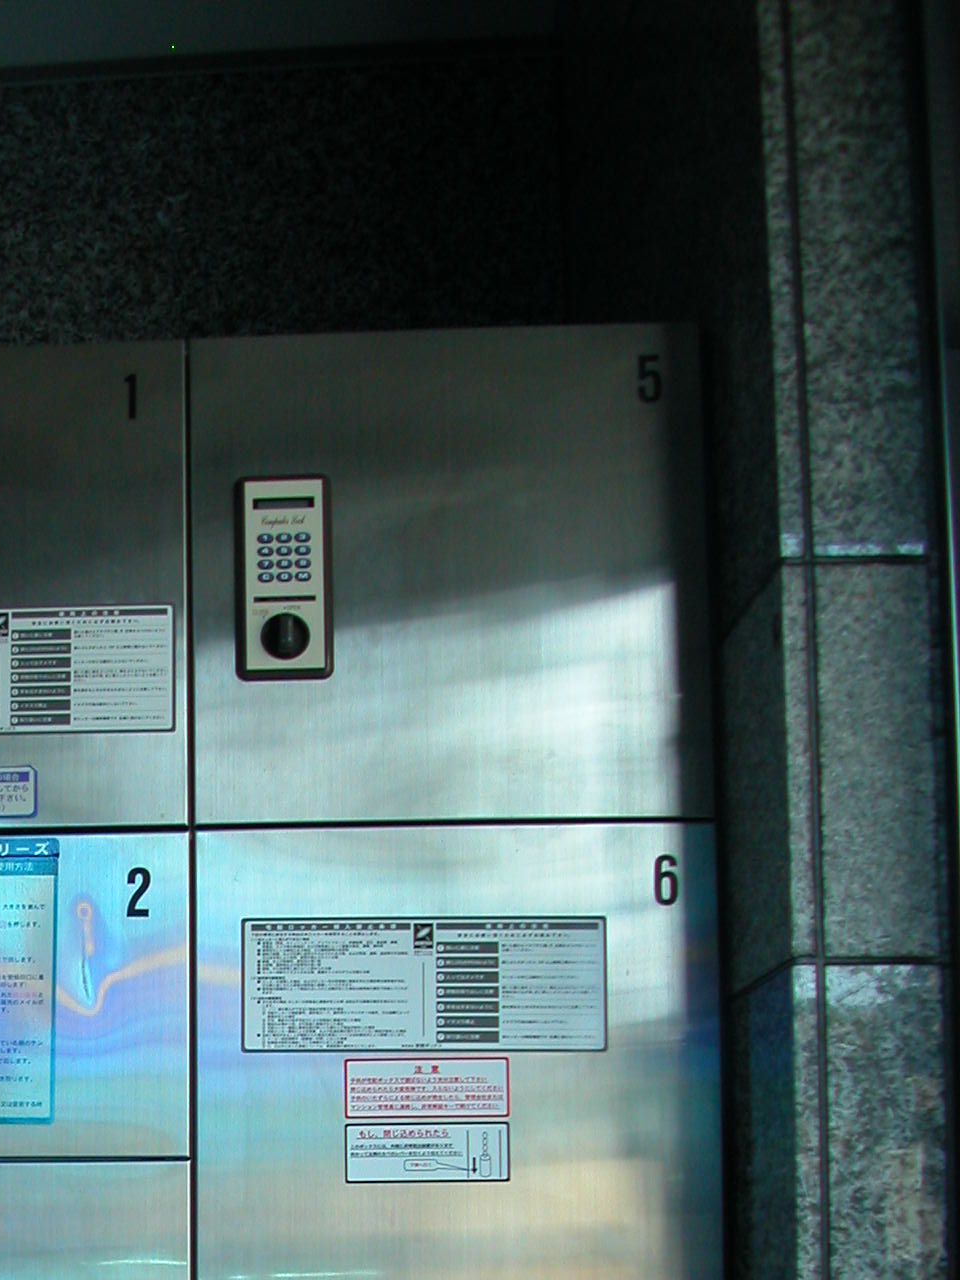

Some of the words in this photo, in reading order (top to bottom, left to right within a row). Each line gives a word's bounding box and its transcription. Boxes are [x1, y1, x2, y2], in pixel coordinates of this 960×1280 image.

[124, 373, 137, 420] 1
[639, 354, 662, 404] 5
[126, 866, 151, 918] 2
[654, 855, 679, 906] 6
